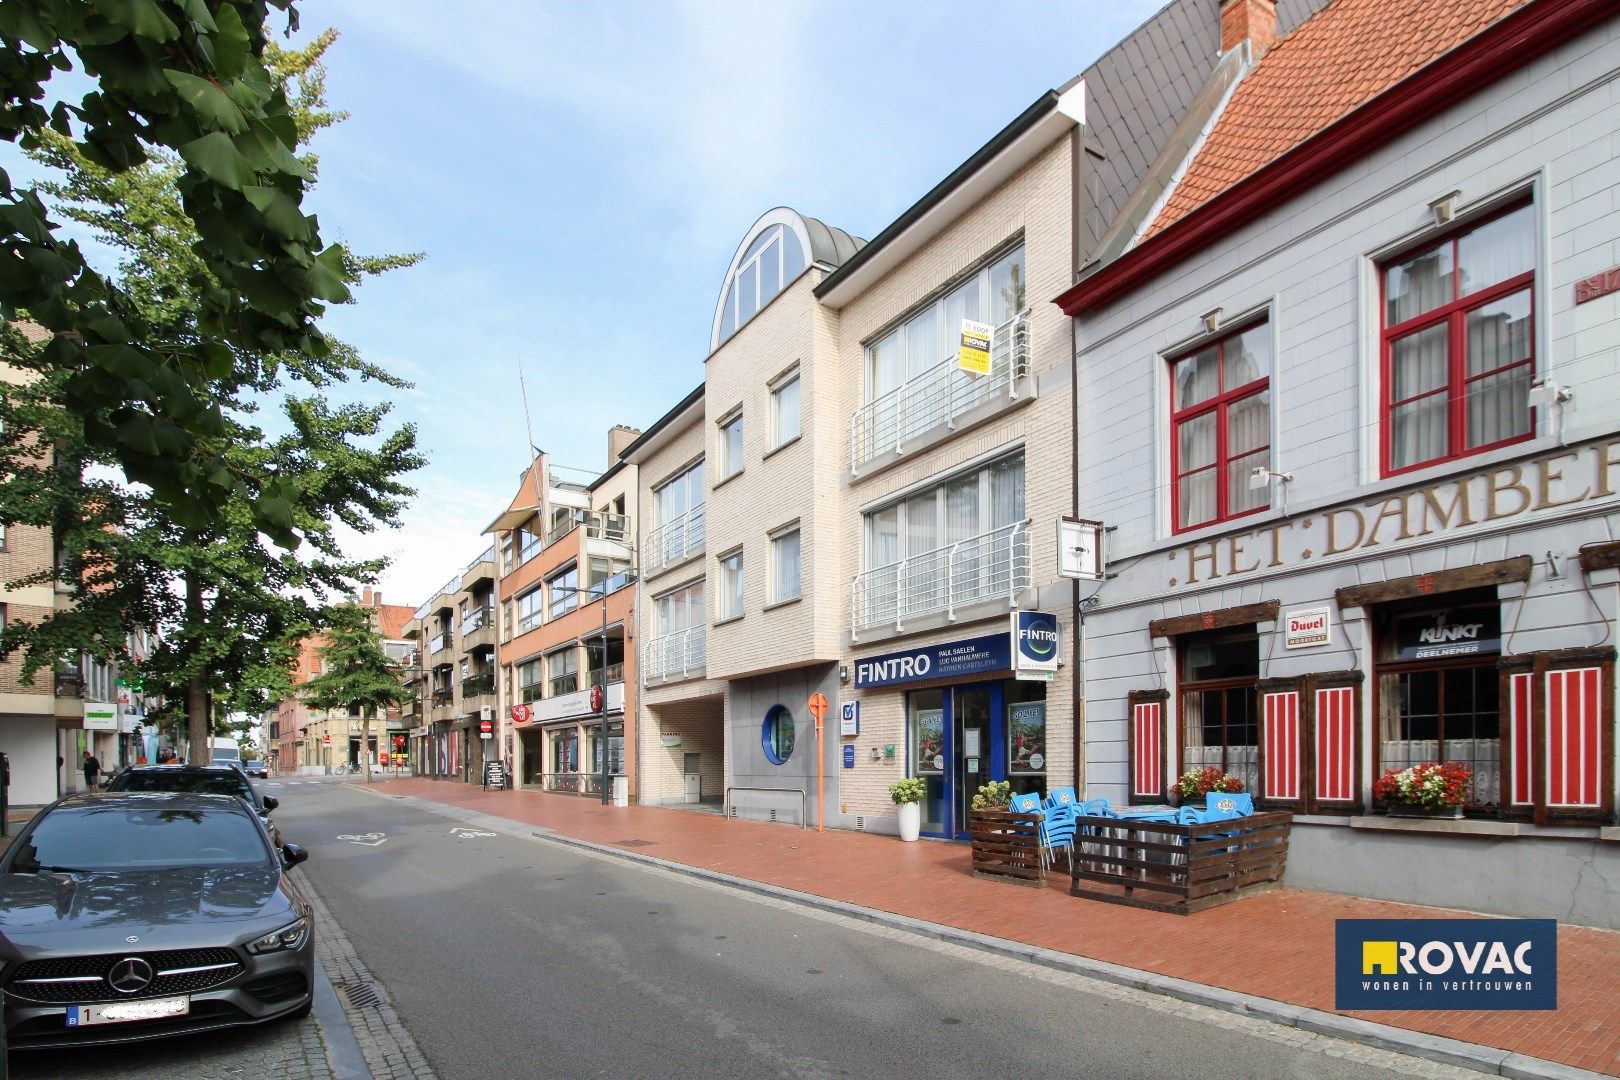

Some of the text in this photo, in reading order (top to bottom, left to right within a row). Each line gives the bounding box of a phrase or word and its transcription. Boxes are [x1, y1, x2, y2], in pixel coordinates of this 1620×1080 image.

[1185, 520, 1294, 584] HET
[1291, 617, 1324, 632] Duvel
[1019, 629, 1057, 642] FINTRO
[952, 645, 975, 655] SAELEN
[1416, 645, 1479, 659] DEELNEMER
[857, 654, 931, 684] FINTRO
